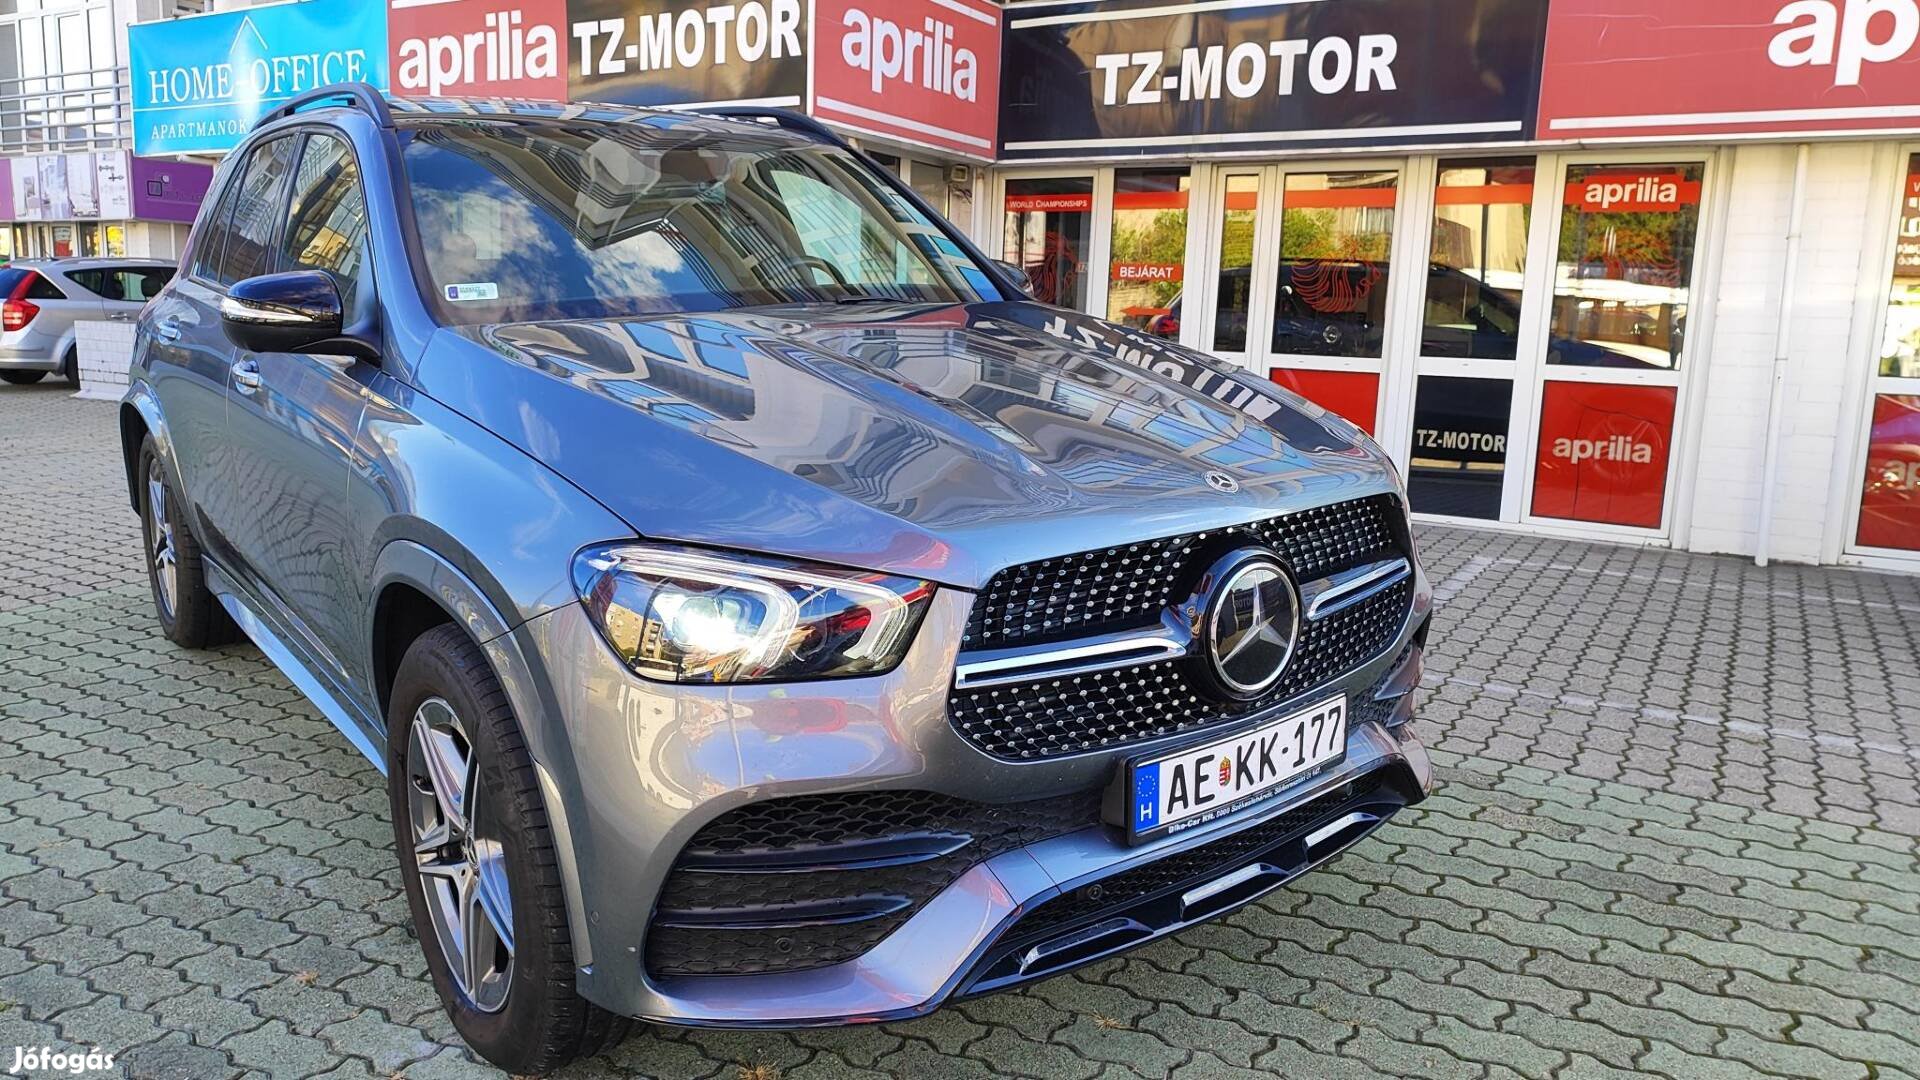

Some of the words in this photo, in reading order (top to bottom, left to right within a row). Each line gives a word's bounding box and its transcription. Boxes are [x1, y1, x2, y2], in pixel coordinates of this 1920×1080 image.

[399, 10, 557, 96] aprilia
[572, 0, 802, 76] TZ-MOTOR
[842, 8, 977, 102] aprilia
[1095, 33, 1398, 106] TZ-MOTOR
[149, 49, 368, 104] HOME-OFFICE
[151, 118, 249, 140] APARTMANOK
[1036, 200, 1088, 208] CHAMPIONSHIPS
[1585, 177, 1677, 208] aprilia
[1119, 265, 1174, 278] BEJÁRAT
[1417, 429, 1506, 453] TZ-MOTOR
[1552, 435, 1653, 464] aprilia
[1167, 755, 1215, 815] AE
[1235, 705, 1342, 792] KK-177
[1140, 802, 1152, 822] H
